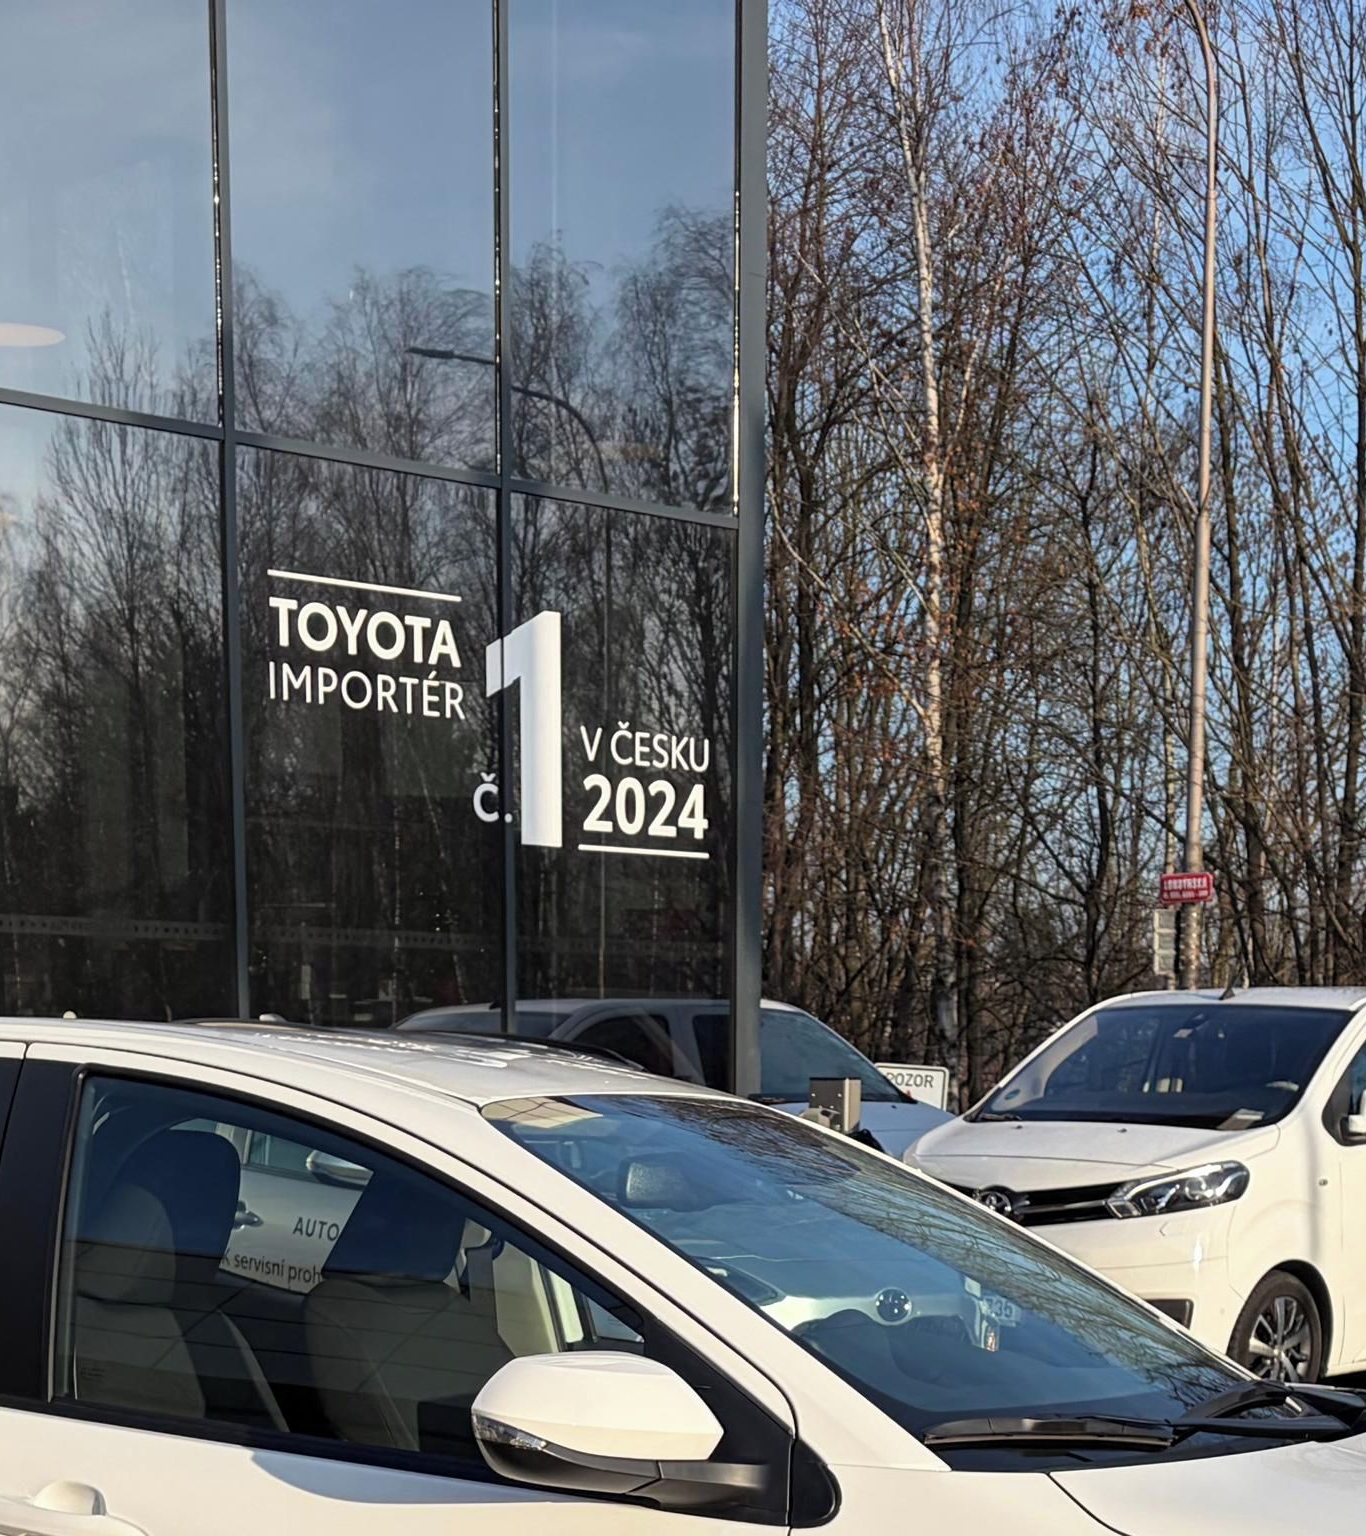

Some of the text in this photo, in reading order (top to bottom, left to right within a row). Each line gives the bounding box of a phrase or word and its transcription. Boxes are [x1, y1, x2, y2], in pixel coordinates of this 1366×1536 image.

[268, 596, 462, 668] TOYOTA
[268, 660, 466, 720] IMPORTÉR
[485, 610, 563, 848] 1
[580, 721, 710, 773] V ČESKU
[582, 773, 709, 840] 2024
[293, 1217, 339, 1242] AUTO
[235, 1254, 285, 1277] servisní
